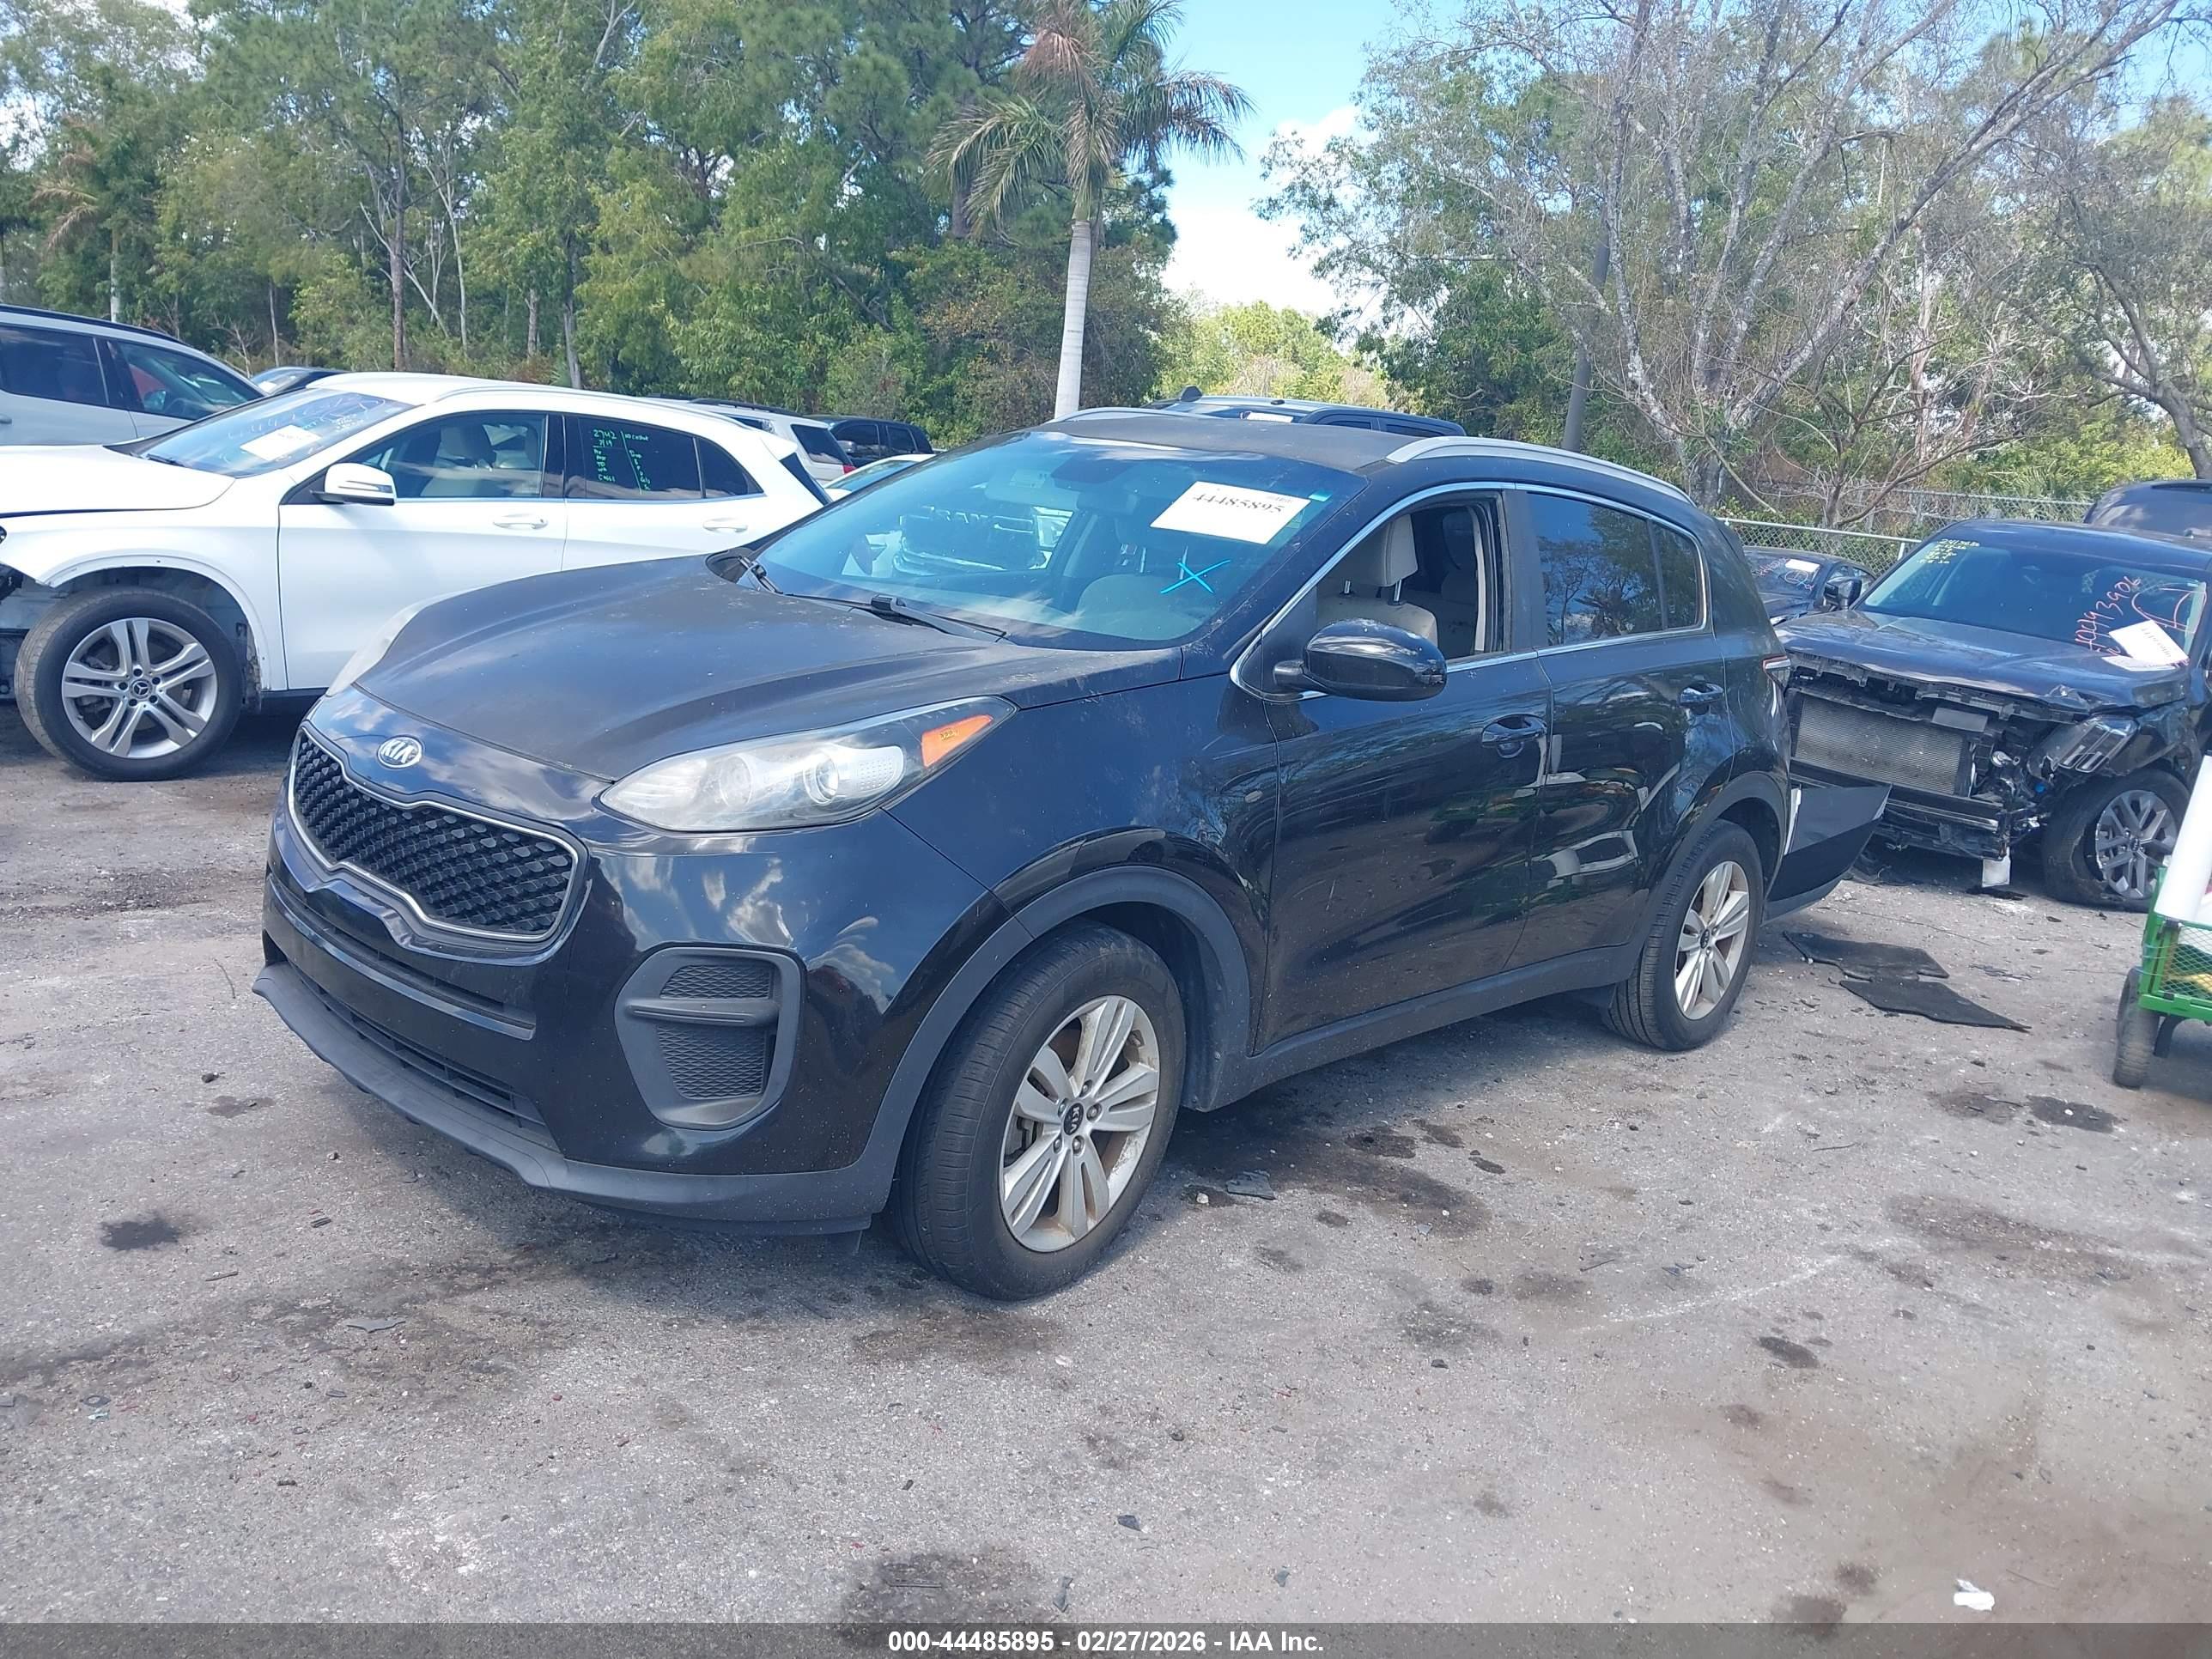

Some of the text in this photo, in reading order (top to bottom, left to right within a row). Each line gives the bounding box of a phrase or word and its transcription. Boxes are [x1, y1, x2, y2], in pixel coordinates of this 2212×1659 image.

[1192, 493, 1285, 514] 44485895
[380, 739, 414, 763] KIA
[1070, 1106, 1080, 1133] KIA
